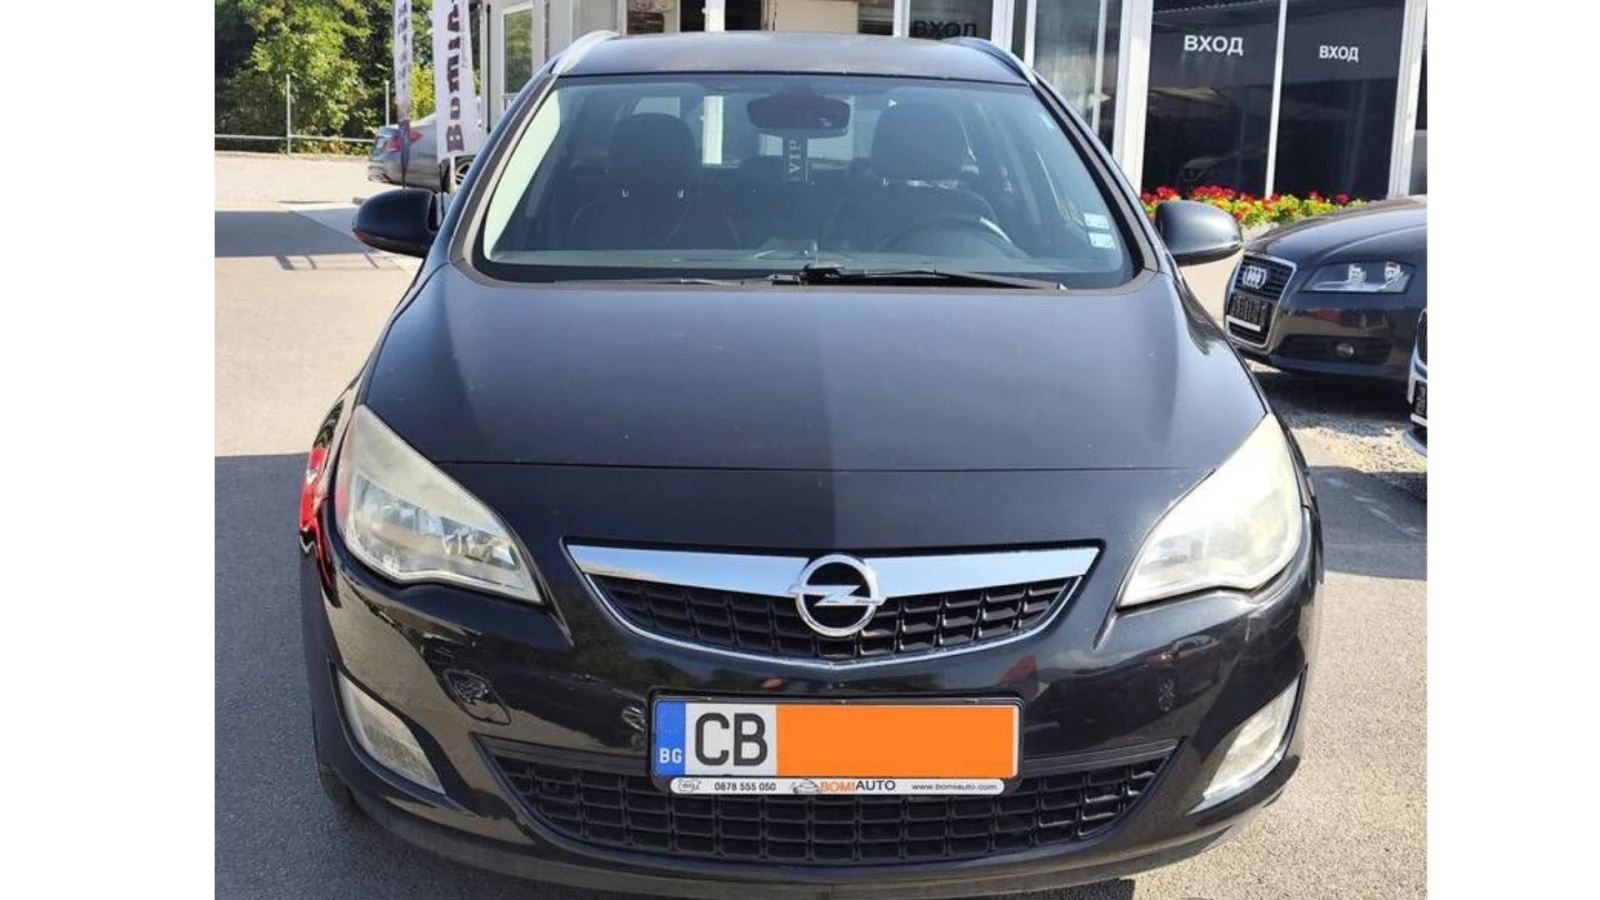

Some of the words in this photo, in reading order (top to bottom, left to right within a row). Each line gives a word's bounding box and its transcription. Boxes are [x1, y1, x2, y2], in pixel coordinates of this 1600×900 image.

[1184, 35, 1244, 56] ВХОД
[1319, 45, 1359, 62] ВХОД
[446, 0, 464, 152] BomiA
[789, 140, 801, 173] VIP
[695, 712, 768, 766] CB
[660, 748, 682, 763] BG
[714, 782, 737, 791] 0878
[740, 782, 757, 791] 555
[759, 782, 777, 791] 050
[911, 783, 997, 791] www.bomiauto.com
